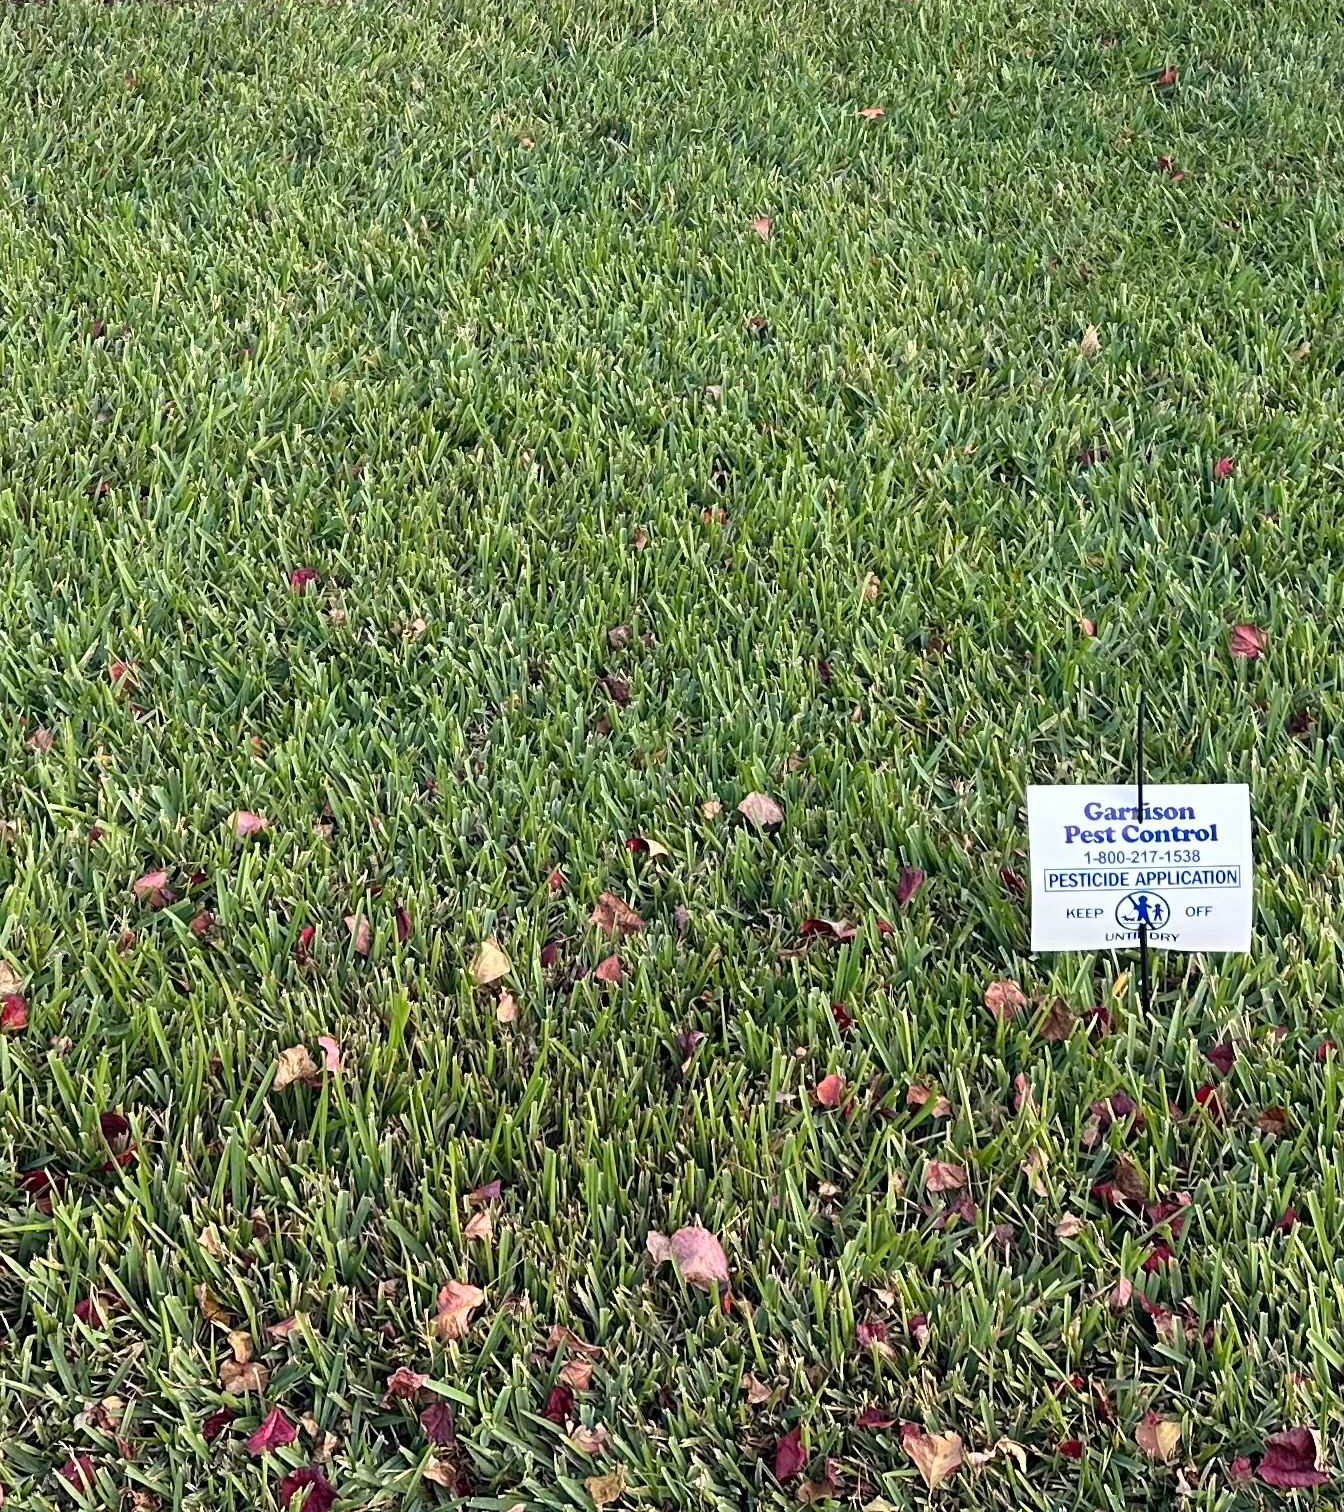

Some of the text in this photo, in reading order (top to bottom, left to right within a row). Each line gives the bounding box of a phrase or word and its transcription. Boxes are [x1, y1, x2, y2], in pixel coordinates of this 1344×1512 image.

[1064, 824, 1218, 844] Pest Control
[1084, 849, 1201, 864] 1-800-217-1538
[1049, 870, 1238, 888] PESTICIDE APPLICATION
[1066, 906, 1214, 919] KEEP OFF
[1105, 932, 1181, 942] UNTI DRY
